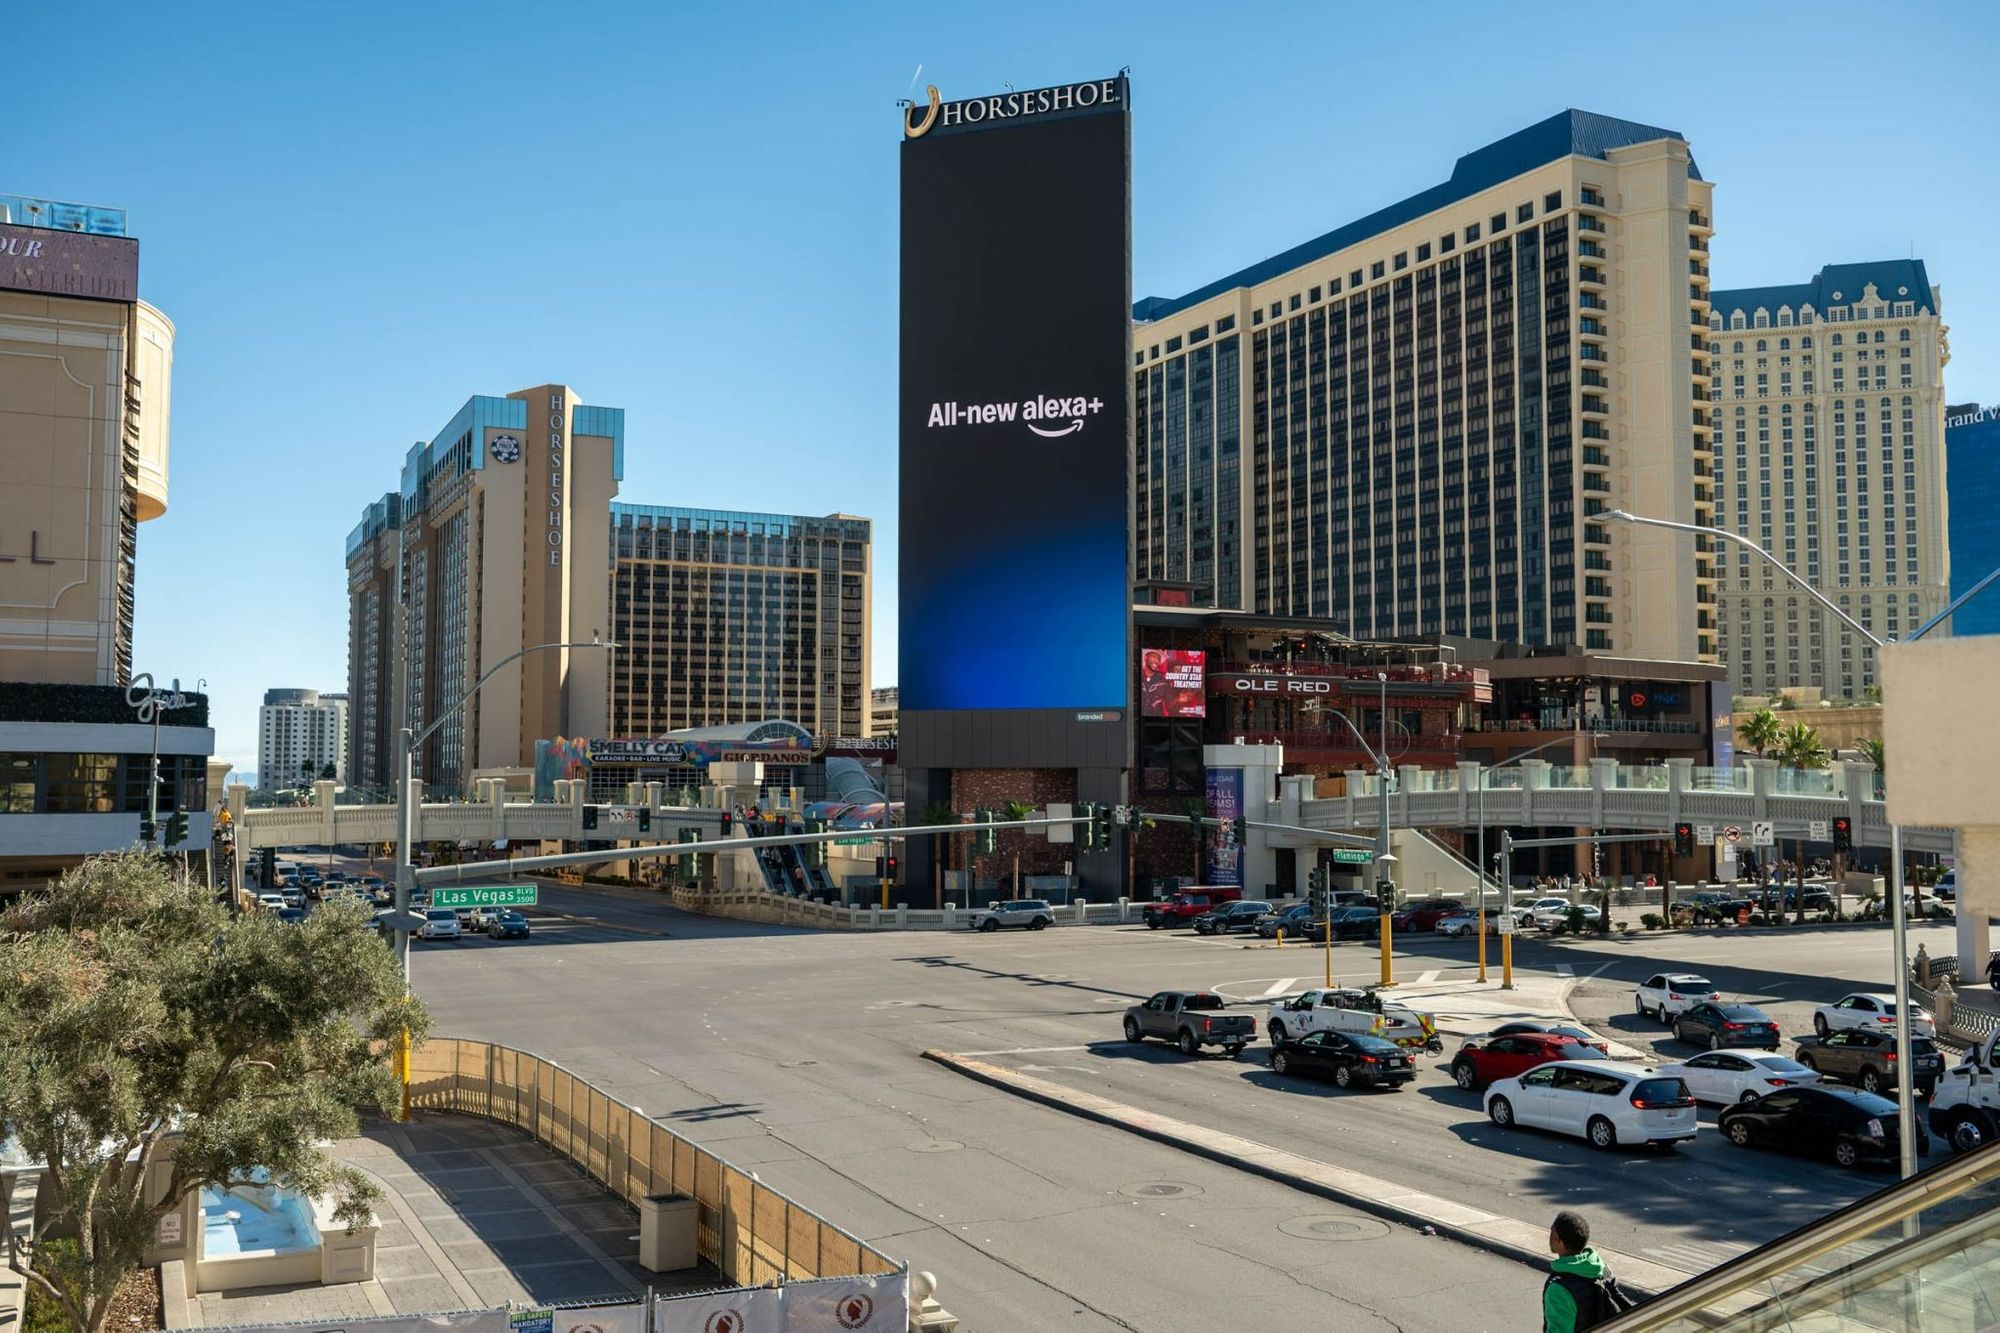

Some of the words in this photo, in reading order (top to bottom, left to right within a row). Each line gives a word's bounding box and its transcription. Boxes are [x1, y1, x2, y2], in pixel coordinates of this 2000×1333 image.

[942, 80, 1115, 126] HORSESHOE
[928, 402, 1018, 427] All-new
[1022, 395, 1104, 420] alexa+
[1944, 407, 1984, 429] rand
[1987, 404, 2000, 420] V
[548, 395, 564, 566] HORSESHOE
[1235, 680, 1279, 691] OLE
[1287, 681, 1330, 693] RED
[590, 742, 649, 754] SMELLY
[653, 742, 684, 754] CAT
[724, 752, 809, 763] GIORDANO'S
[1336, 851, 1365, 862] Flamingo
[442, 890, 467, 903] Las
[473, 889, 514, 905] Vegas
[516, 887, 534, 895] BLVD
